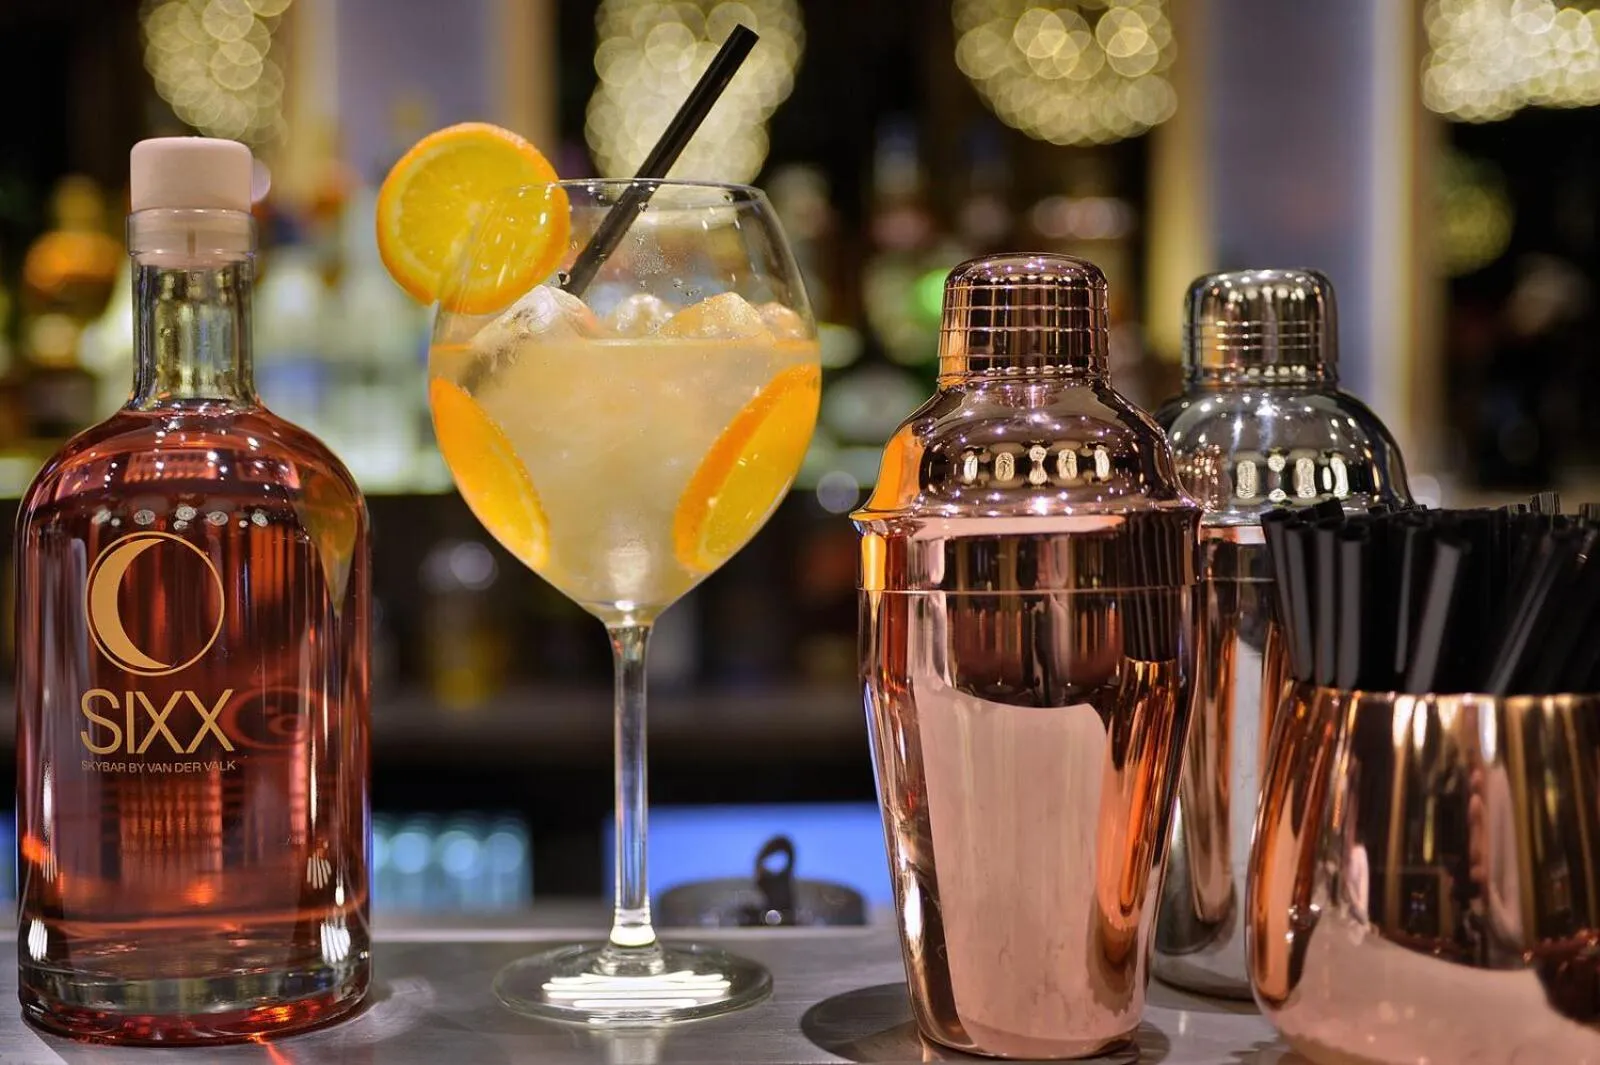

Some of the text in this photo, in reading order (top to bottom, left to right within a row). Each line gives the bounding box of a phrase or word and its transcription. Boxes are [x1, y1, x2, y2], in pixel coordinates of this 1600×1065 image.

[81, 688, 235, 754] SIXX
[81, 760, 236, 773] SKYBAR BY VAN DER VALK
